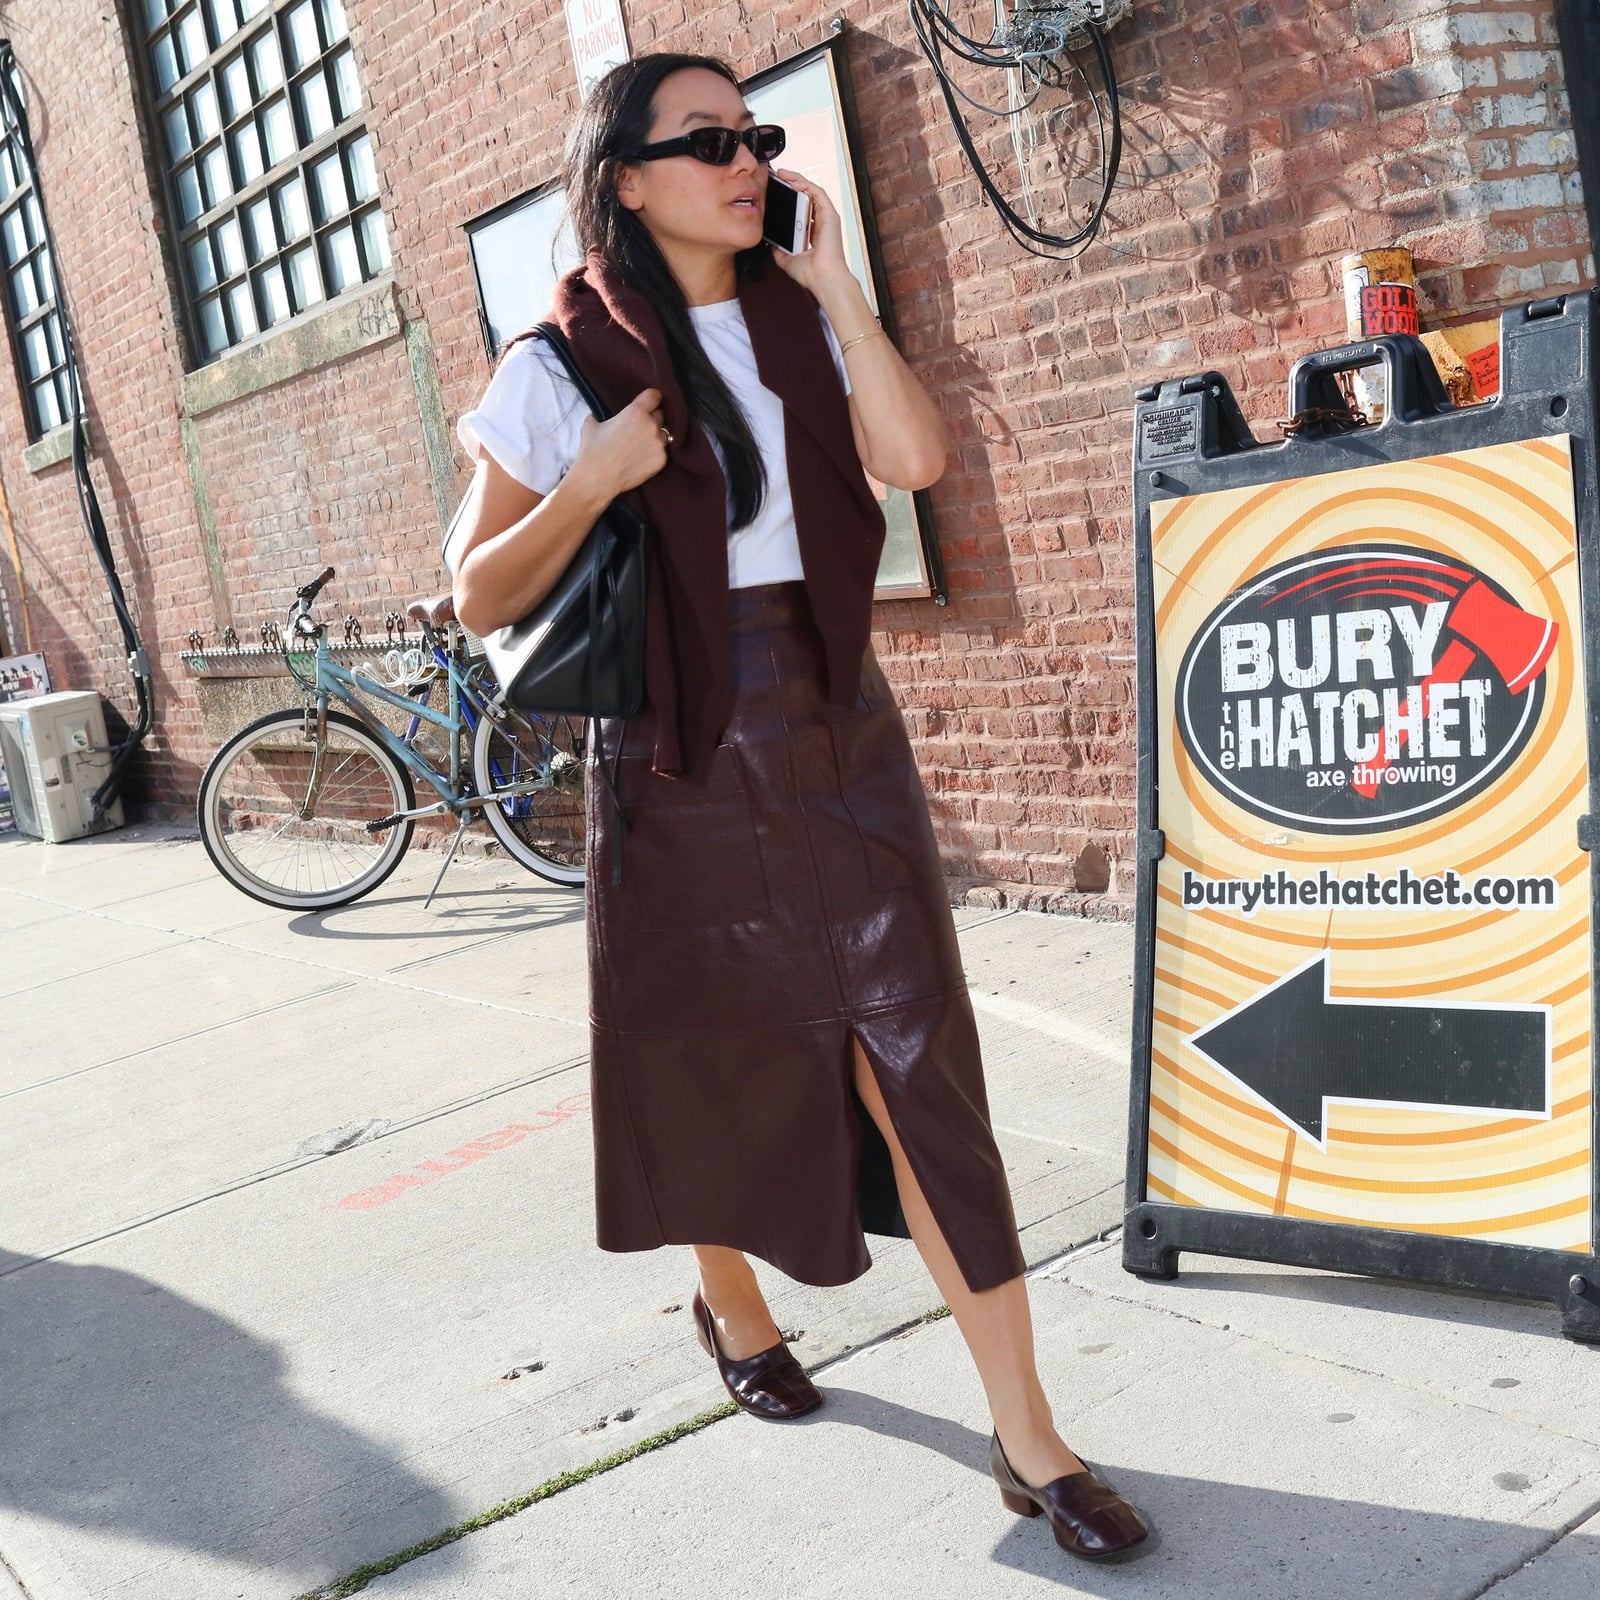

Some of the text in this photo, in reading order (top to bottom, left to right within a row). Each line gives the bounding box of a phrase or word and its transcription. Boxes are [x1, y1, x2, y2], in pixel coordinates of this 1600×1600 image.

[582, 0, 602, 27] NO
[577, 18, 620, 64] PARKING
[1220, 601, 1450, 693] BURY
[1220, 678, 1492, 770] the HATCHET
[1306, 761, 1457, 788] axe throwing
[1183, 869, 1555, 912] burythehatchet.com
